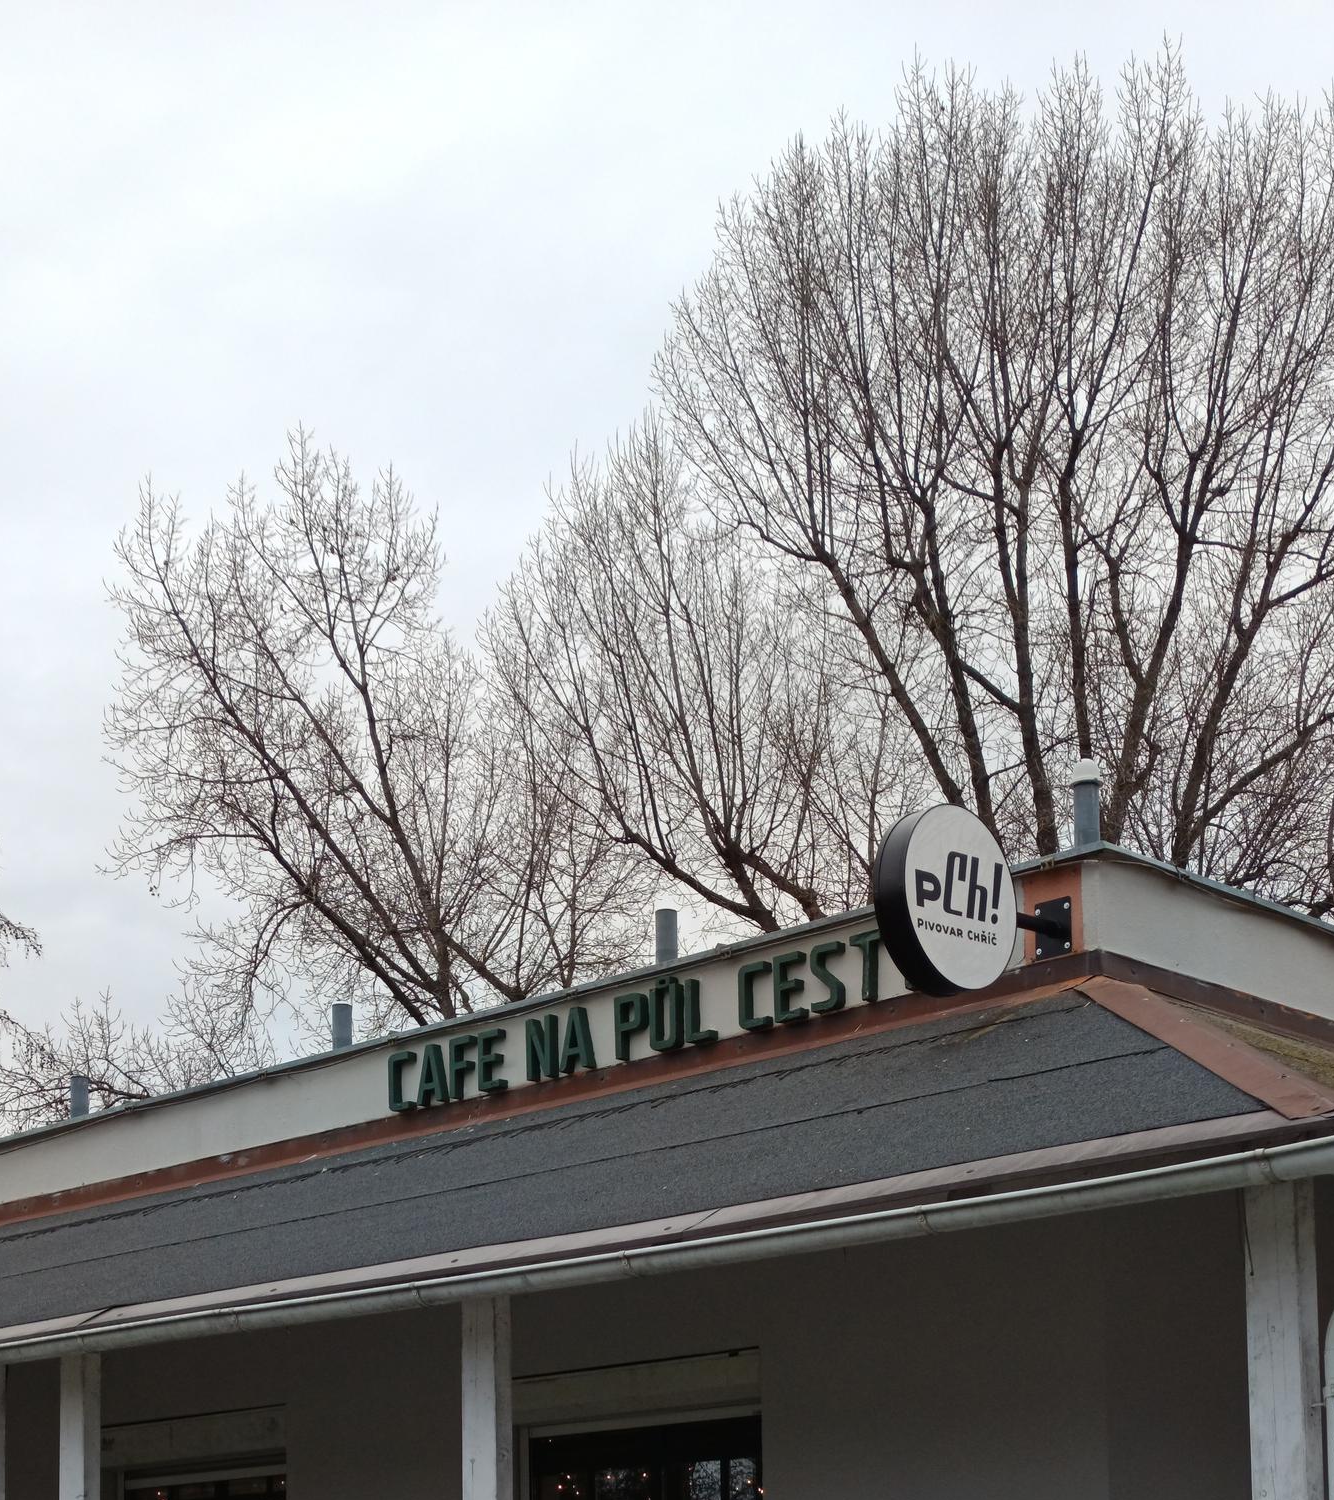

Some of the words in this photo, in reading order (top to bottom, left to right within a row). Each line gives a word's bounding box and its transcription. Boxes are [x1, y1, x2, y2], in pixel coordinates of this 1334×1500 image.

[917, 917, 964, 938] PIVOVAR
[967, 930, 998, 946] CHŘÍČ
[388, 1028, 508, 1112] CAFE
[525, 1006, 597, 1082] NA
[614, 976, 719, 1061] PŮL
[737, 929, 882, 1032] CEST
